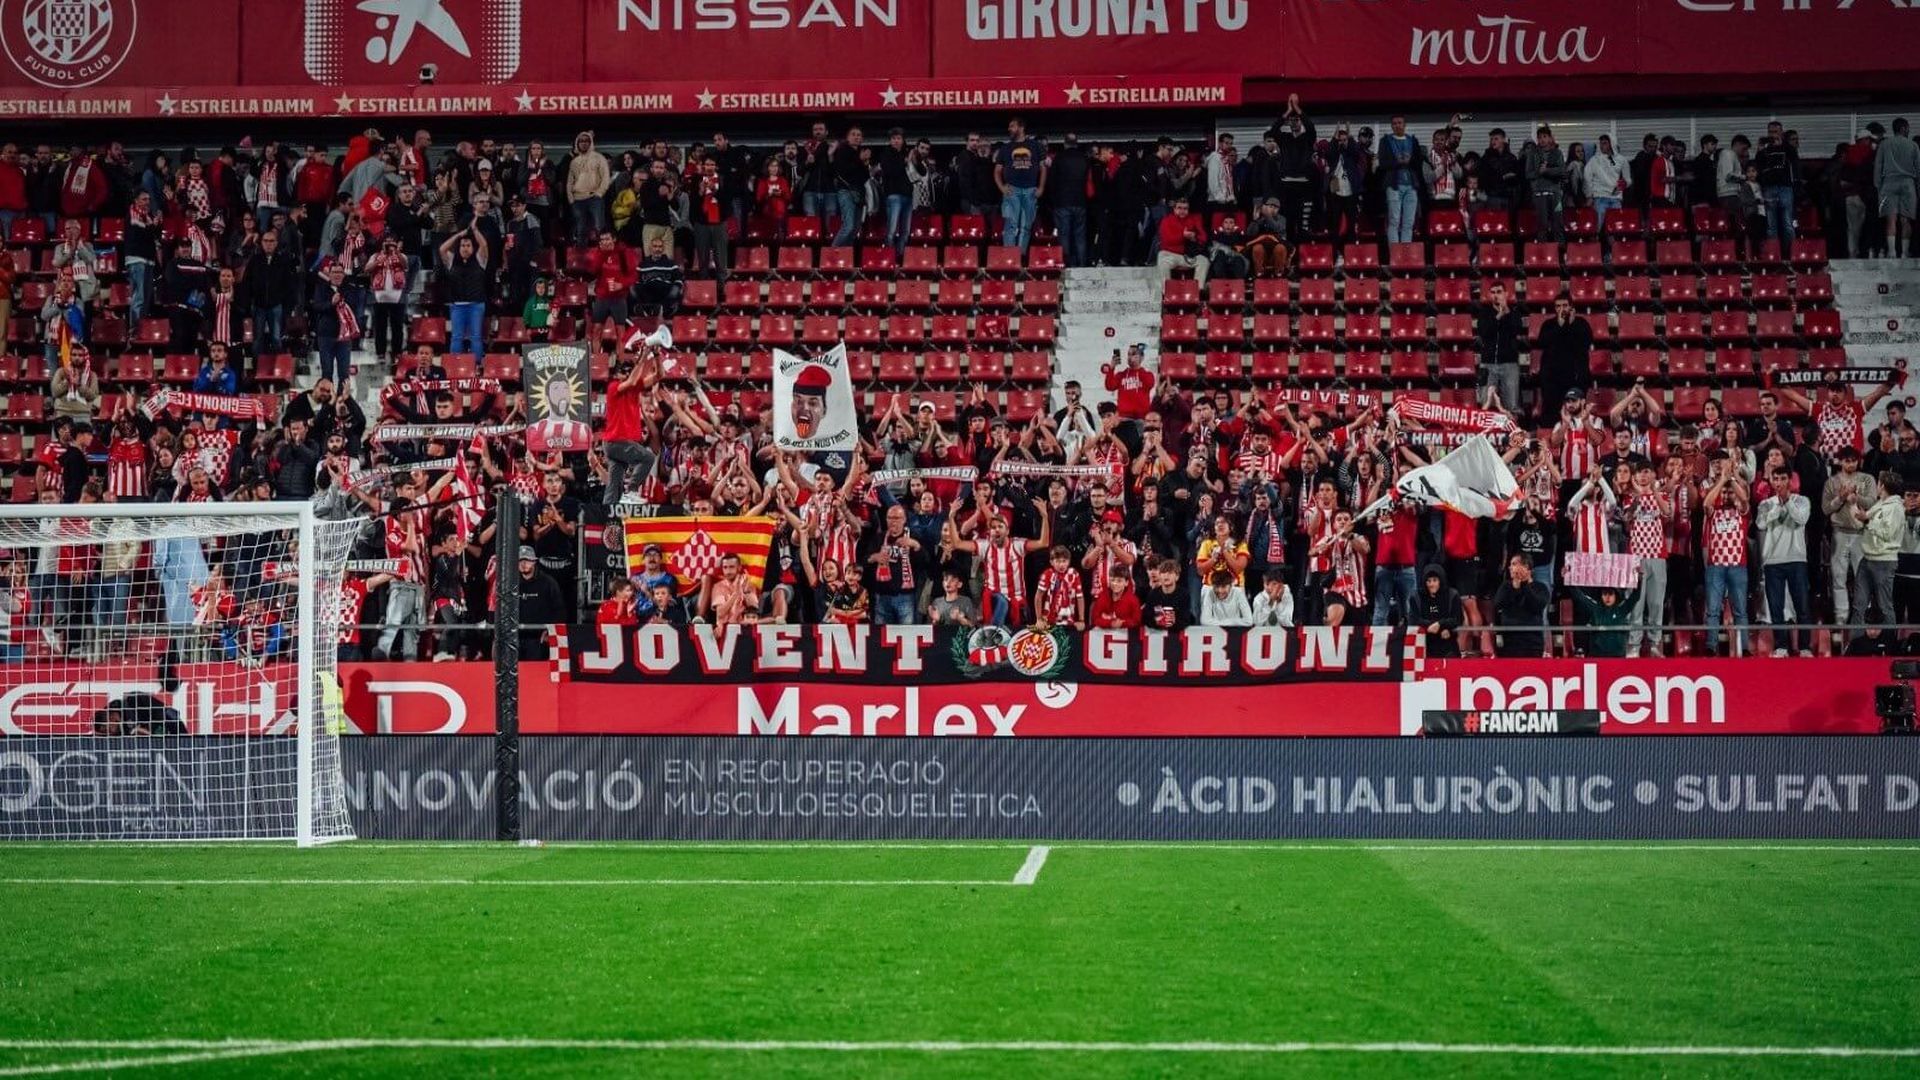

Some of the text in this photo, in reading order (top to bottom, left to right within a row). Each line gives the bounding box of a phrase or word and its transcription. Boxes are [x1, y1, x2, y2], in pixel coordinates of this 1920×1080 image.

[617, 0, 898, 31] NISSAN
[1410, 14, 1605, 66] mutua
[24, 54, 112, 79] FUTBOL CLUB
[0, 99, 132, 115] ESTRELLA DAMM
[181, 98, 314, 114] ESTRELLA DAMM
[359, 96, 492, 112] ESTRELLA DAMM
[539, 94, 673, 111] ESTRELLA DAMM
[721, 92, 855, 109] ESTRELLA DAMM
[904, 89, 1039, 106] ESTRELLA DAMM
[1089, 87, 1225, 103] ESTRELLA DAMM
[1780, 371, 1821, 383] AMOR
[177, 392, 240, 413] GIRONA FC
[1422, 403, 1486, 427] GIRONA FC
[1411, 432, 1444, 446] HEM
[607, 503, 661, 518] JOVENT
[580, 623, 934, 674] JOVENT
[1460, 663, 1726, 724] parlem
[0, 681, 467, 735] ETIHD
[737, 686, 1028, 736] Marlex
[1463, 711, 1559, 733] #FANCAM
[663, 756, 945, 785] EN RECUPERACIÓ
[336, 758, 643, 812] NNOVACIÓ
[1152, 766, 1616, 814] ÀCID HIALURÒNIC
[1675, 774, 1868, 812] SULFAT
[664, 788, 1042, 818] MUSCULOESQUELÈTICA
